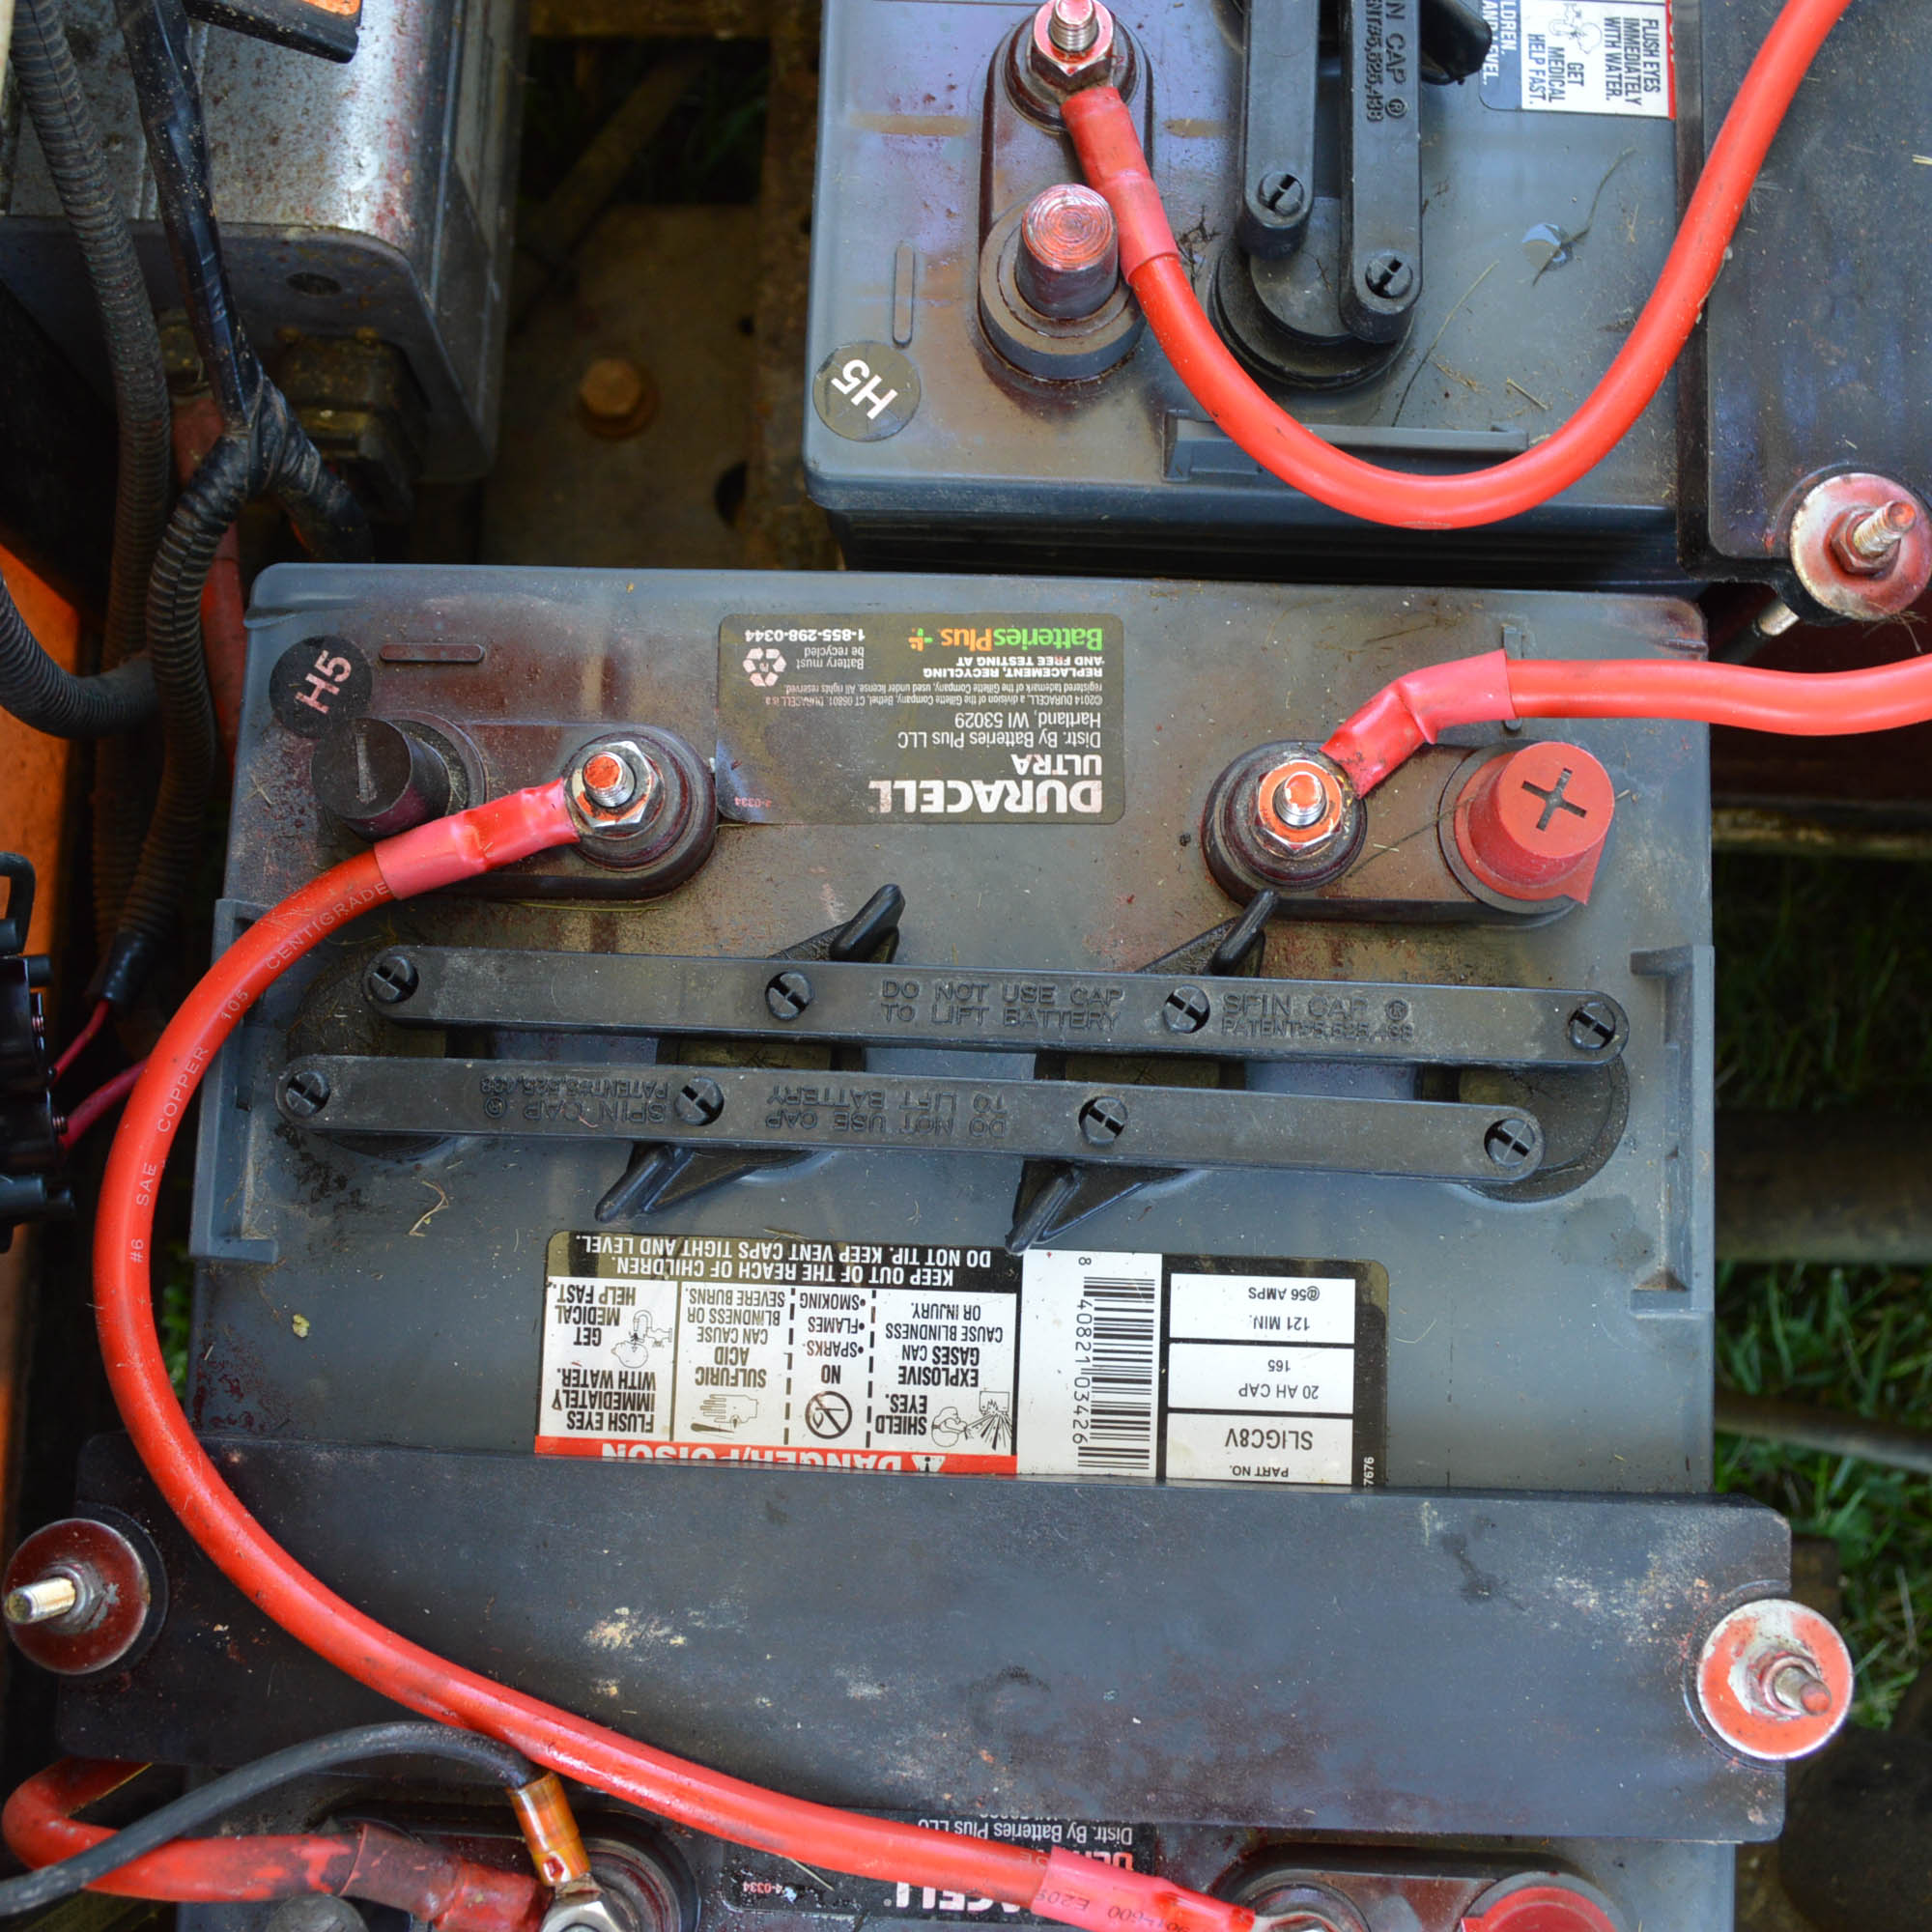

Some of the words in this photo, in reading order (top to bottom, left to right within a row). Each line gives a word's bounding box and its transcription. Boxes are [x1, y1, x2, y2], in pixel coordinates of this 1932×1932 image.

[1604, 16, 1621, 50] WITH
[1642, 18, 1660, 57] FLUSH
[1386, 33, 1406, 84] CAP
[1528, 34, 1546, 65] HELP
[1623, 17, 1641, 105] IMMEDIATELY
[1548, 46, 1565, 102] MEDICAL
[1567, 62, 1584, 86] GET
[1605, 53, 1623, 101] WATER.
[1643, 62, 1661, 93] EYES
[1528, 70, 1546, 104] FAST.
[831, 359, 898, 419] H5
[744, 629, 866, 642] 1-855-298-0344
[804, 644, 848, 658] recycled
[851, 646, 865, 657] be
[796, 659, 823, 669] must
[827, 657, 865, 669] Battery
[955, 657, 973, 667] AT
[977, 656, 1034, 667] TESTING
[1037, 656, 1070, 667] FREE
[1074, 657, 1103, 667] AND
[295, 649, 352, 714] H5
[923, 668, 1000, 678] RECYCLING
[1002, 667, 1103, 677] REPLACEMENT,
[821, 683, 843, 695] rights
[844, 684, 856, 695] All
[888, 683, 910, 694] under
[912, 683, 931, 694] used
[973, 683, 1000, 694] Gillette
[1002, 683, 1014, 694] the
[1015, 683, 1024, 694] of
[1064, 681, 1102, 694] registered
[765, 696, 771, 704] a
[773, 696, 780, 706] is
[855, 696, 866, 706] CT
[935, 696, 963, 706] Gillette
[964, 695, 978, 705] the
[979, 695, 986, 705] of
[988, 695, 1018, 706] division
[1020, 695, 1025, 703] a
[954, 712, 1003, 728] 53029
[1008, 712, 1029, 728] WI
[1034, 710, 1100, 728] Hartland,
[897, 731, 926, 748] LLC
[932, 731, 964, 748] Plus
[969, 731, 1034, 748] Batteries
[1038, 728, 1058, 748] By
[1063, 731, 1100, 749] Distr.
[1010, 753, 1102, 776] ULTRA
[868, 780, 1102, 813] DURACELL
[265, 881, 389, 971] CENTIGRADE
[880, 979, 920, 999] DO
[935, 981, 989, 1002] NOT
[1002, 982, 1056, 1005] USE
[1070, 985, 1124, 1007] CAP
[220, 990, 249, 1022] 105
[1221, 992, 1293, 1016] SPIN
[1307, 994, 1369, 1018] CAP
[880, 1003, 916, 1023] TO
[931, 1004, 989, 1026] LIFT
[1002, 1007, 1122, 1030] BATTERY
[156, 1046, 210, 1133] COPPER
[766, 1086, 887, 1110] BATTERY
[524, 1099, 582, 1122] CAP
[899, 1090, 957, 1112] LIFT
[973, 1093, 1007, 1114] TO
[598, 1101, 668, 1123] SPIN
[765, 1110, 818, 1131] CAP
[833, 1111, 887, 1134] USE
[900, 1112, 953, 1136] NOT
[969, 1118, 1007, 1139] DO
[135, 1162, 157, 1207] SAE
[129, 1238, 144, 1264] #6
[576, 1235, 634, 1255] LEVEL.
[639, 1237, 676, 1256] AND
[680, 1238, 732, 1258] TIGHT
[738, 1241, 783, 1261] CAPS
[787, 1243, 834, 1263] VENT
[838, 1245, 883, 1264] KEEP
[889, 1246, 921, 1265] TIP.
[924, 1248, 960, 1266] NOT
[966, 1249, 991, 1268] DO
[1078, 1257, 1092, 1265] 8
[611, 1256, 705, 1278] CHILDREN.
[710, 1260, 733, 1278] OF
[739, 1261, 797, 1281] REACH
[802, 1264, 836, 1282] THE
[839, 1265, 864, 1283] OF
[868, 1265, 905, 1285] OUT
[909, 1267, 953, 1287] KEEP
[553, 1284, 594, 1304] FAST.
[598, 1286, 637, 1306] HELP
[685, 1288, 733, 1306] BURNS.
[736, 1289, 785, 1308] SEVERE
[1248, 1287, 1287, 1300] AMPS
[1291, 1286, 1321, 1301] @56
[554, 1305, 620, 1326] MEDICAL
[687, 1307, 705, 1323] OR
[709, 1307, 781, 1326] BLINDNESS
[910, 1302, 959, 1321] INJURY.
[963, 1304, 981, 1321] OR
[885, 1322, 957, 1342] BLINDNESS
[1075, 1299, 1093, 1363] 40821
[1249, 1315, 1281, 1330] MIN.
[1287, 1317, 1310, 1331] 121
[574, 1326, 602, 1347] GET
[696, 1325, 739, 1345] CAUSE
[742, 1327, 768, 1346] CAN
[961, 1325, 1004, 1343] CAUSE
[714, 1346, 750, 1366] ACID
[901, 1345, 927, 1361] CAN
[932, 1345, 980, 1367] GASES
[821, 1364, 841, 1384] NO
[1267, 1359, 1291, 1373] 165
[556, 1368, 614, 1389] WATER.
[618, 1370, 656, 1391] WITH
[695, 1367, 767, 1388] SULFURIC
[897, 1365, 980, 1388] EXPLOSIVE
[1237, 1383, 1270, 1398] CAP
[1276, 1384, 1298, 1399] AH
[1302, 1385, 1320, 1400] 20
[552, 1389, 655, 1412] IMMEDIATELY
[885, 1394, 927, 1413] EYES.
[1072, 1377, 1090, 1444] 03426
[567, 1410, 604, 1432] EYES
[609, 1412, 654, 1434] FLUSH
[874, 1414, 927, 1436] SHIELD
[1225, 1428, 1314, 1451] SLIGC8V
[1229, 1465, 1251, 1476] NO.
[1255, 1466, 1289, 1478] PART
[954, 1821, 988, 1839] Plus
[993, 1823, 1063, 1843] Batteries
[1066, 1822, 1088, 1845] By
[1092, 1826, 1132, 1845] Distr.
